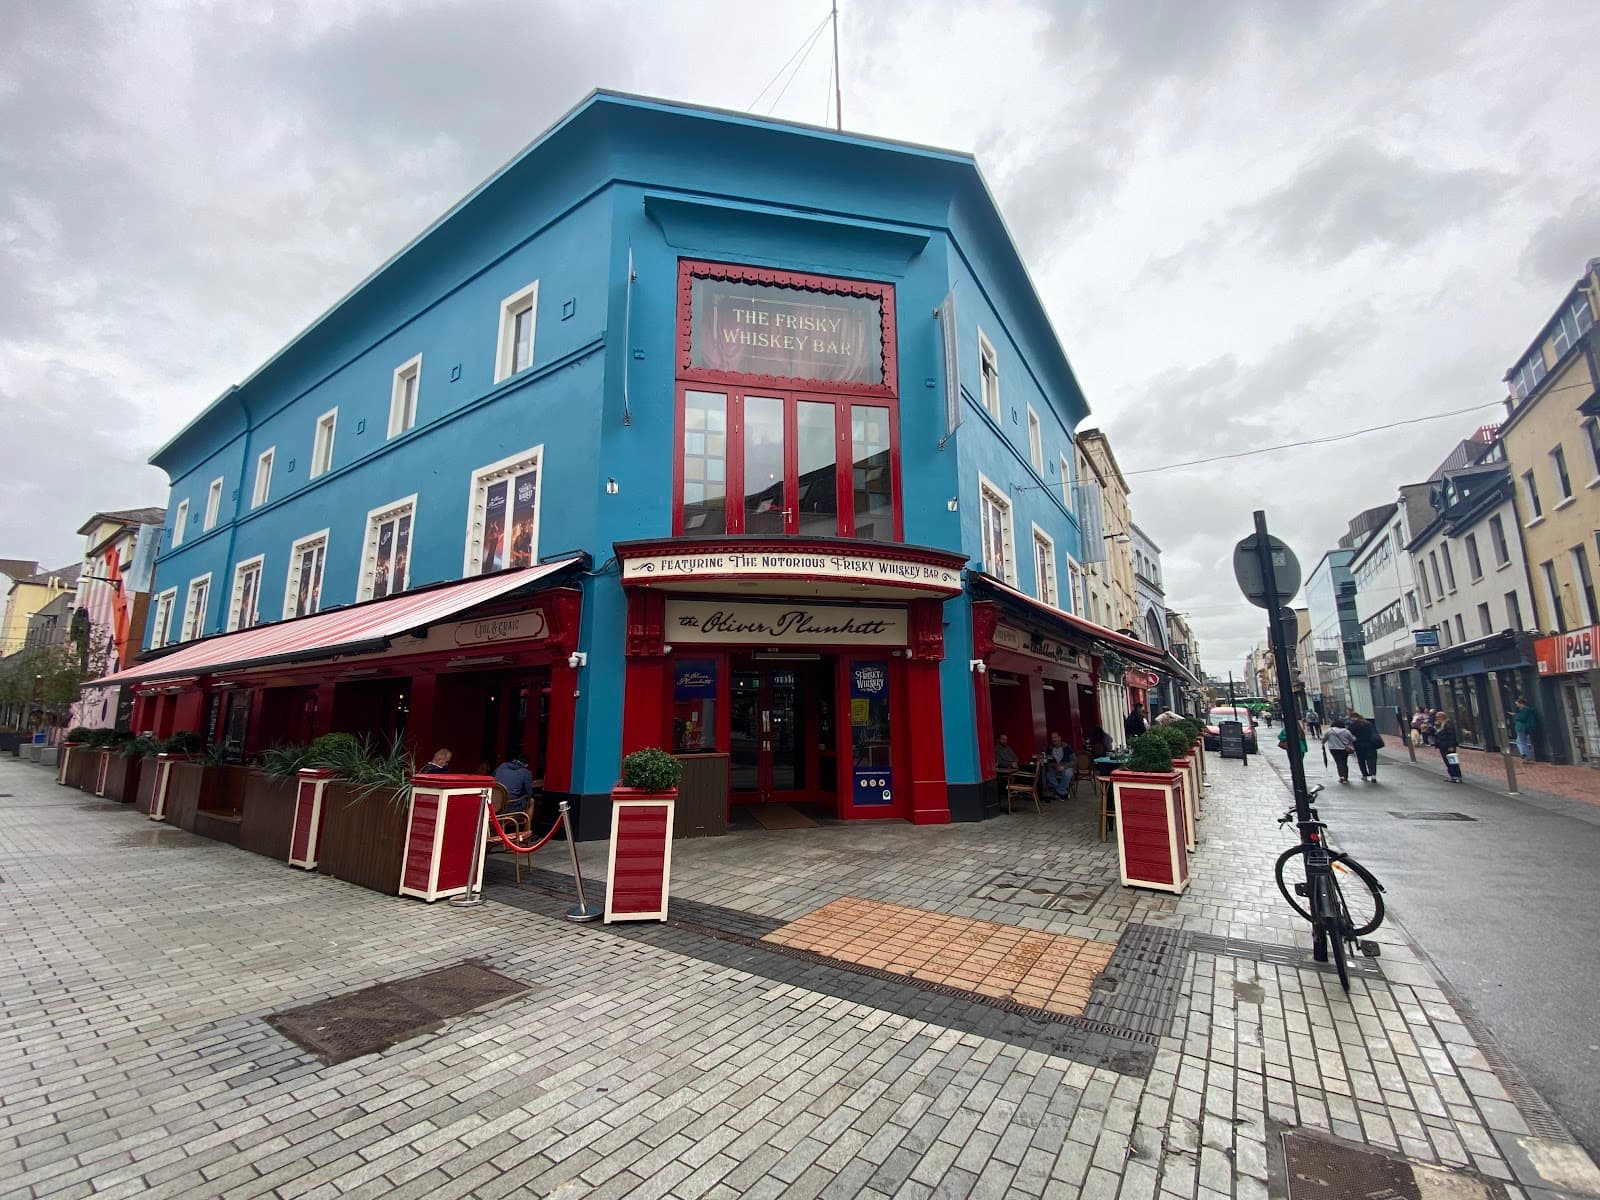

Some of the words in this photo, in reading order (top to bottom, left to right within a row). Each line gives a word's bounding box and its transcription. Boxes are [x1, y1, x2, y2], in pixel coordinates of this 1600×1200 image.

[733, 309, 769, 325] THE
[776, 313, 841, 333] FRISKY
[723, 328, 808, 351] WHISKEY
[814, 340, 851, 356] BAR
[661, 558, 723, 573] FEATURING
[762, 556, 825, 568] NOTORIOUS
[830, 557, 875, 571] FRISKY
[879, 562, 920, 579] WHISKEY
[923, 567, 939, 579] BAR
[678, 616, 699, 627] the
[700, 611, 771, 634] Oliver
[769, 611, 896, 636] Plunkett
[1566, 632, 1591, 658] PAB
